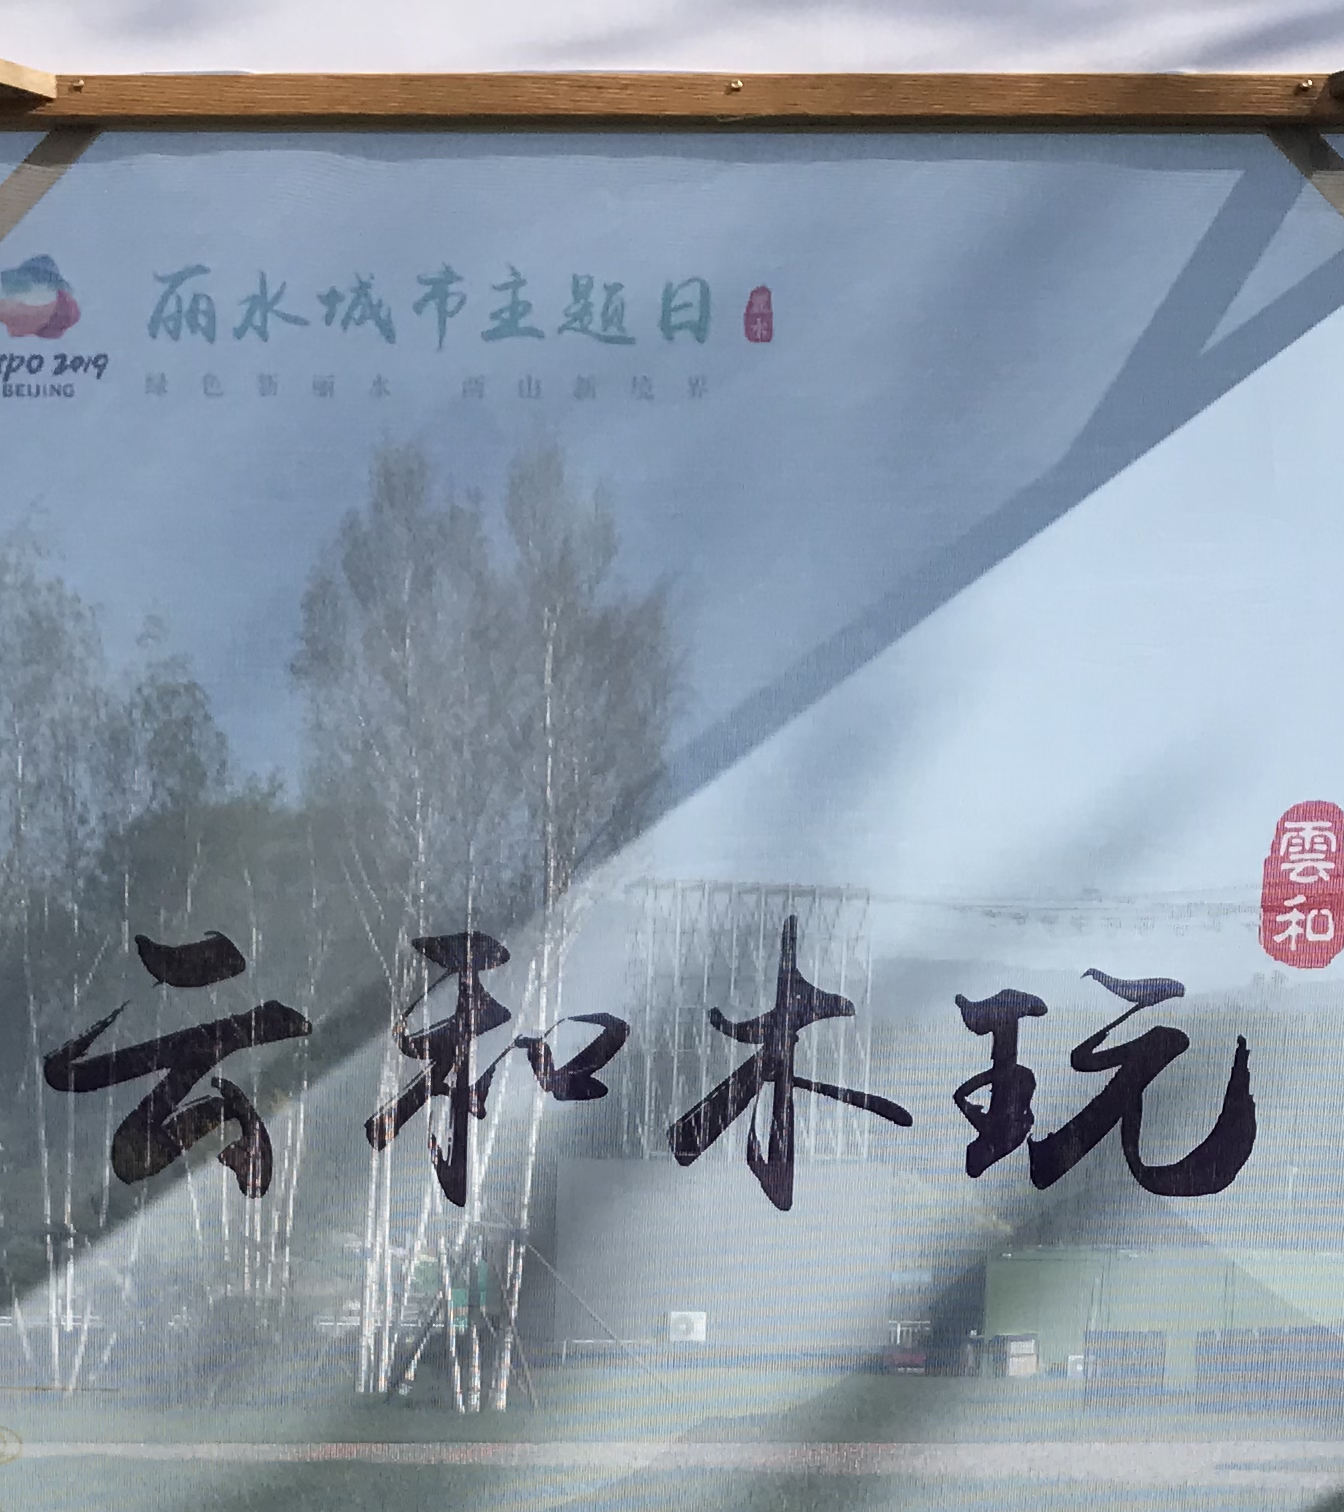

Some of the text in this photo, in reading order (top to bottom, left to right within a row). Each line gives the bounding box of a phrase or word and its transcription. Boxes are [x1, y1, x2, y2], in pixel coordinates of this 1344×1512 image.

[147, 262, 712, 350] 丽水城市主题日
[2, 383, 75, 398] BEIJING
[53, 353, 108, 379] 2019
[46, 915, 1258, 1211] 云和木玩
